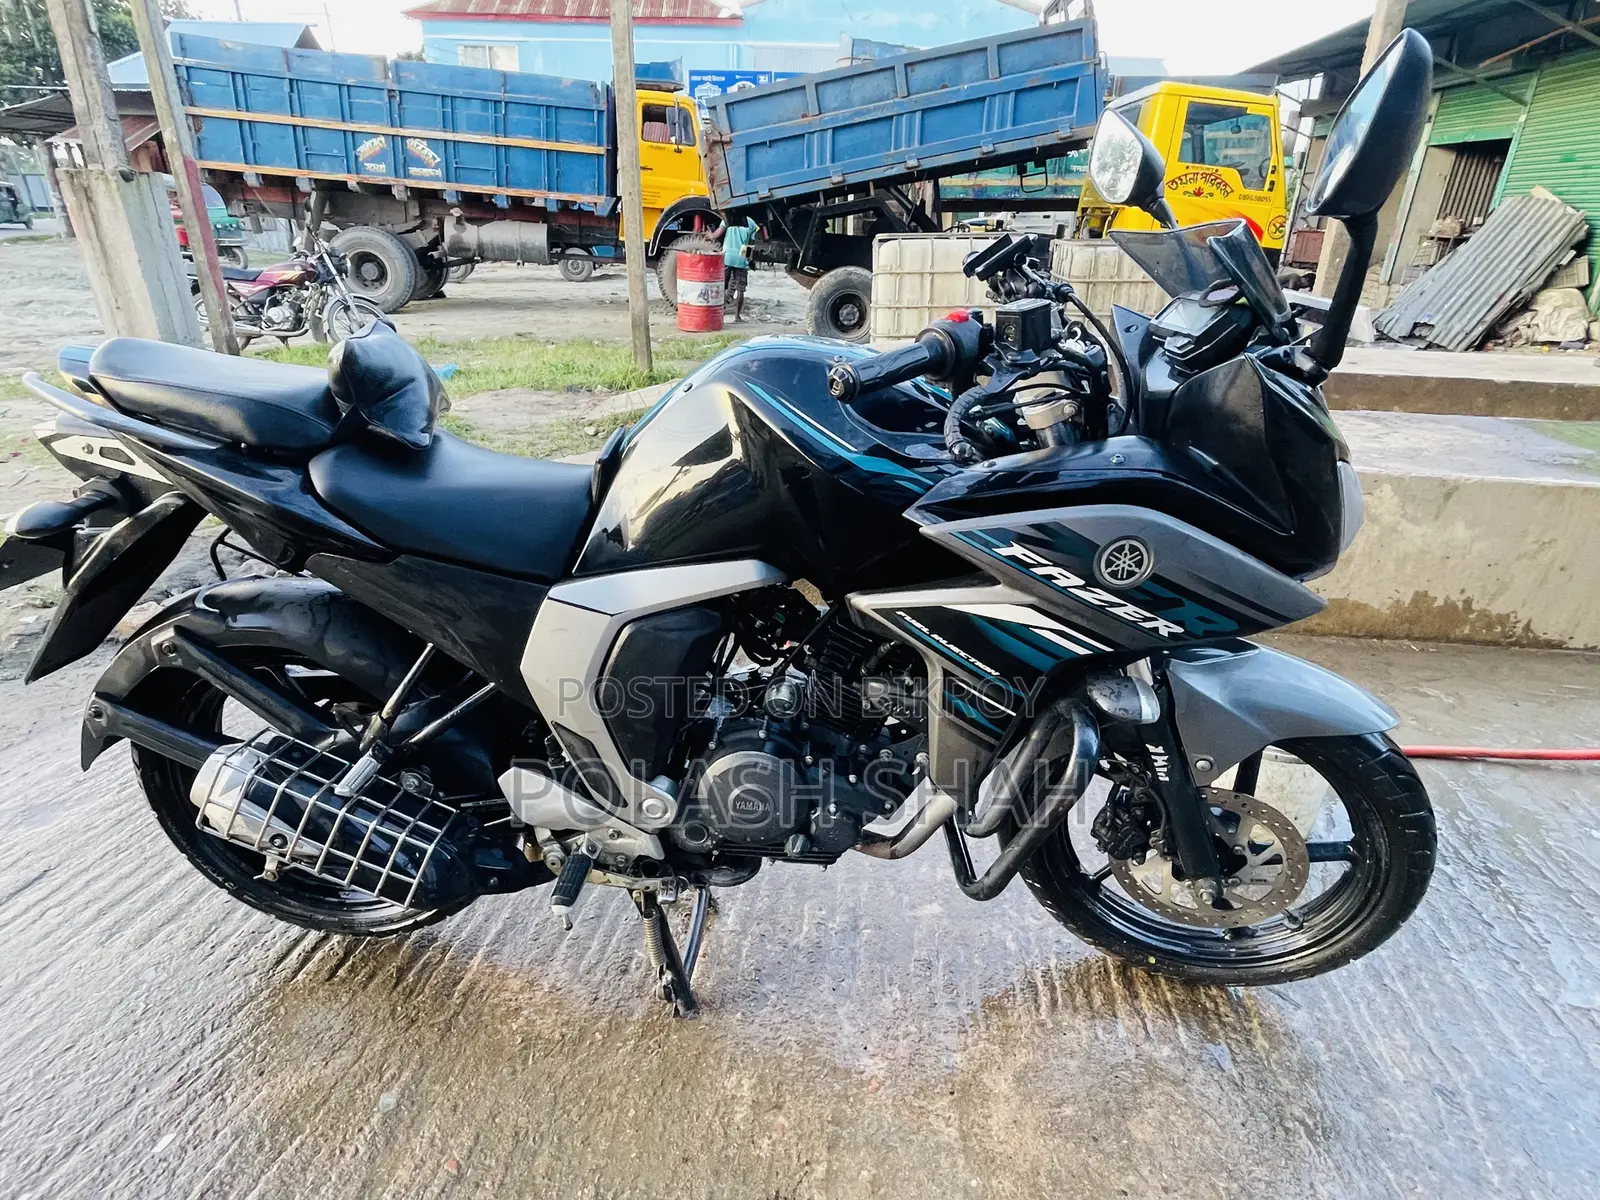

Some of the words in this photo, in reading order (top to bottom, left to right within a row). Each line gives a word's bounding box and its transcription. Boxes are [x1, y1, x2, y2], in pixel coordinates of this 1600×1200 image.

[991, 540, 1185, 638] FAZER
[896, 610, 930, 635] FUEL
[930, 633, 1001, 676] INJECTION
[735, 801, 771, 811] YAMAHA
